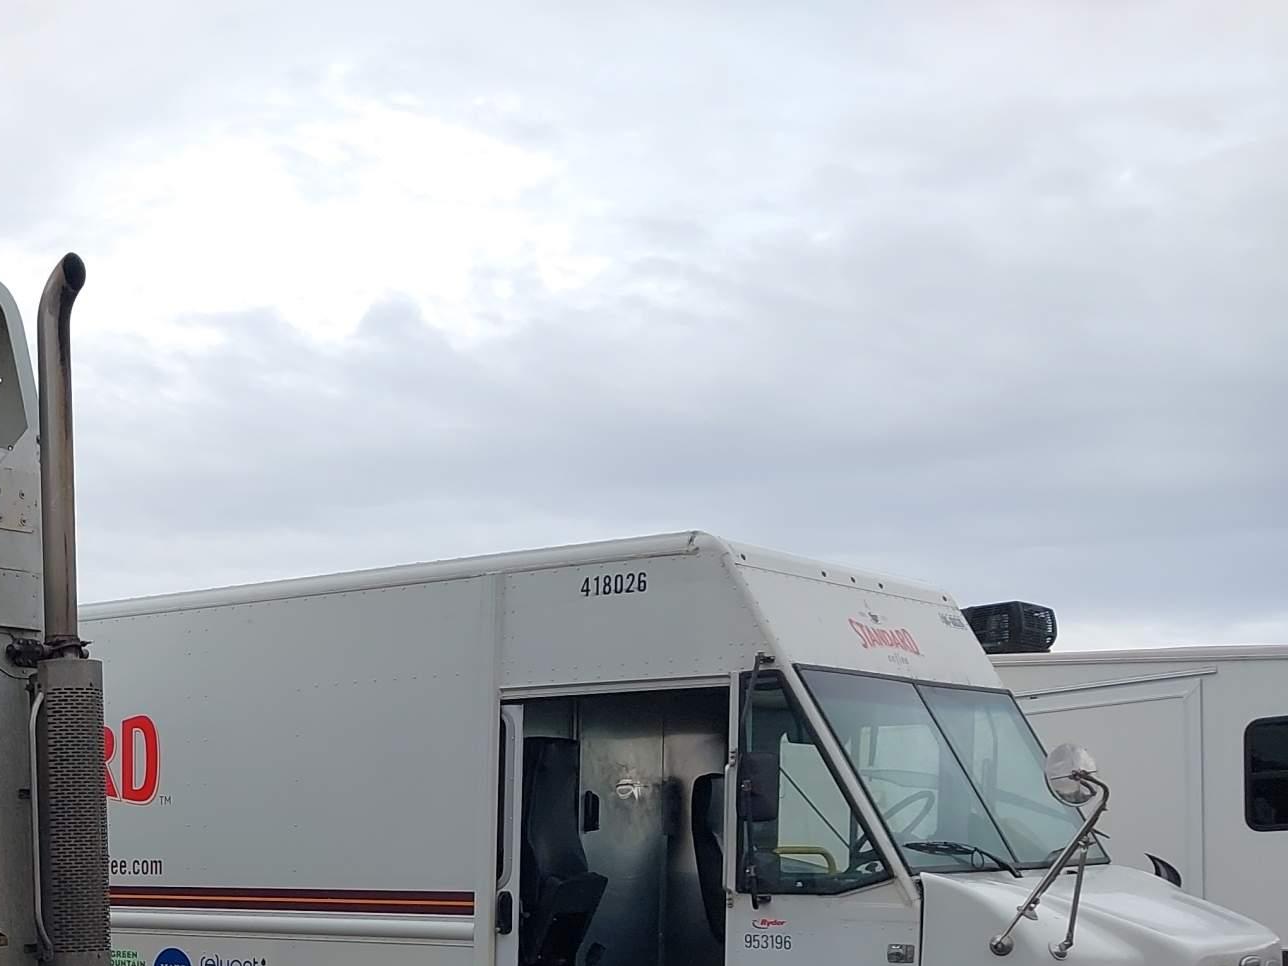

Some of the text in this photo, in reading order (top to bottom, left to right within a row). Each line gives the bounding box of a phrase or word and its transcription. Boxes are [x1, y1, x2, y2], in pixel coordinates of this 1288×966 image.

[580, 572, 648, 597] 418026
[847, 617, 921, 656] STANDARD
[159, 795, 172, 806] TM
[109, 858, 163, 876] ee.com
[744, 933, 792, 950] 953196
[110, 950, 138, 959] GREEN
